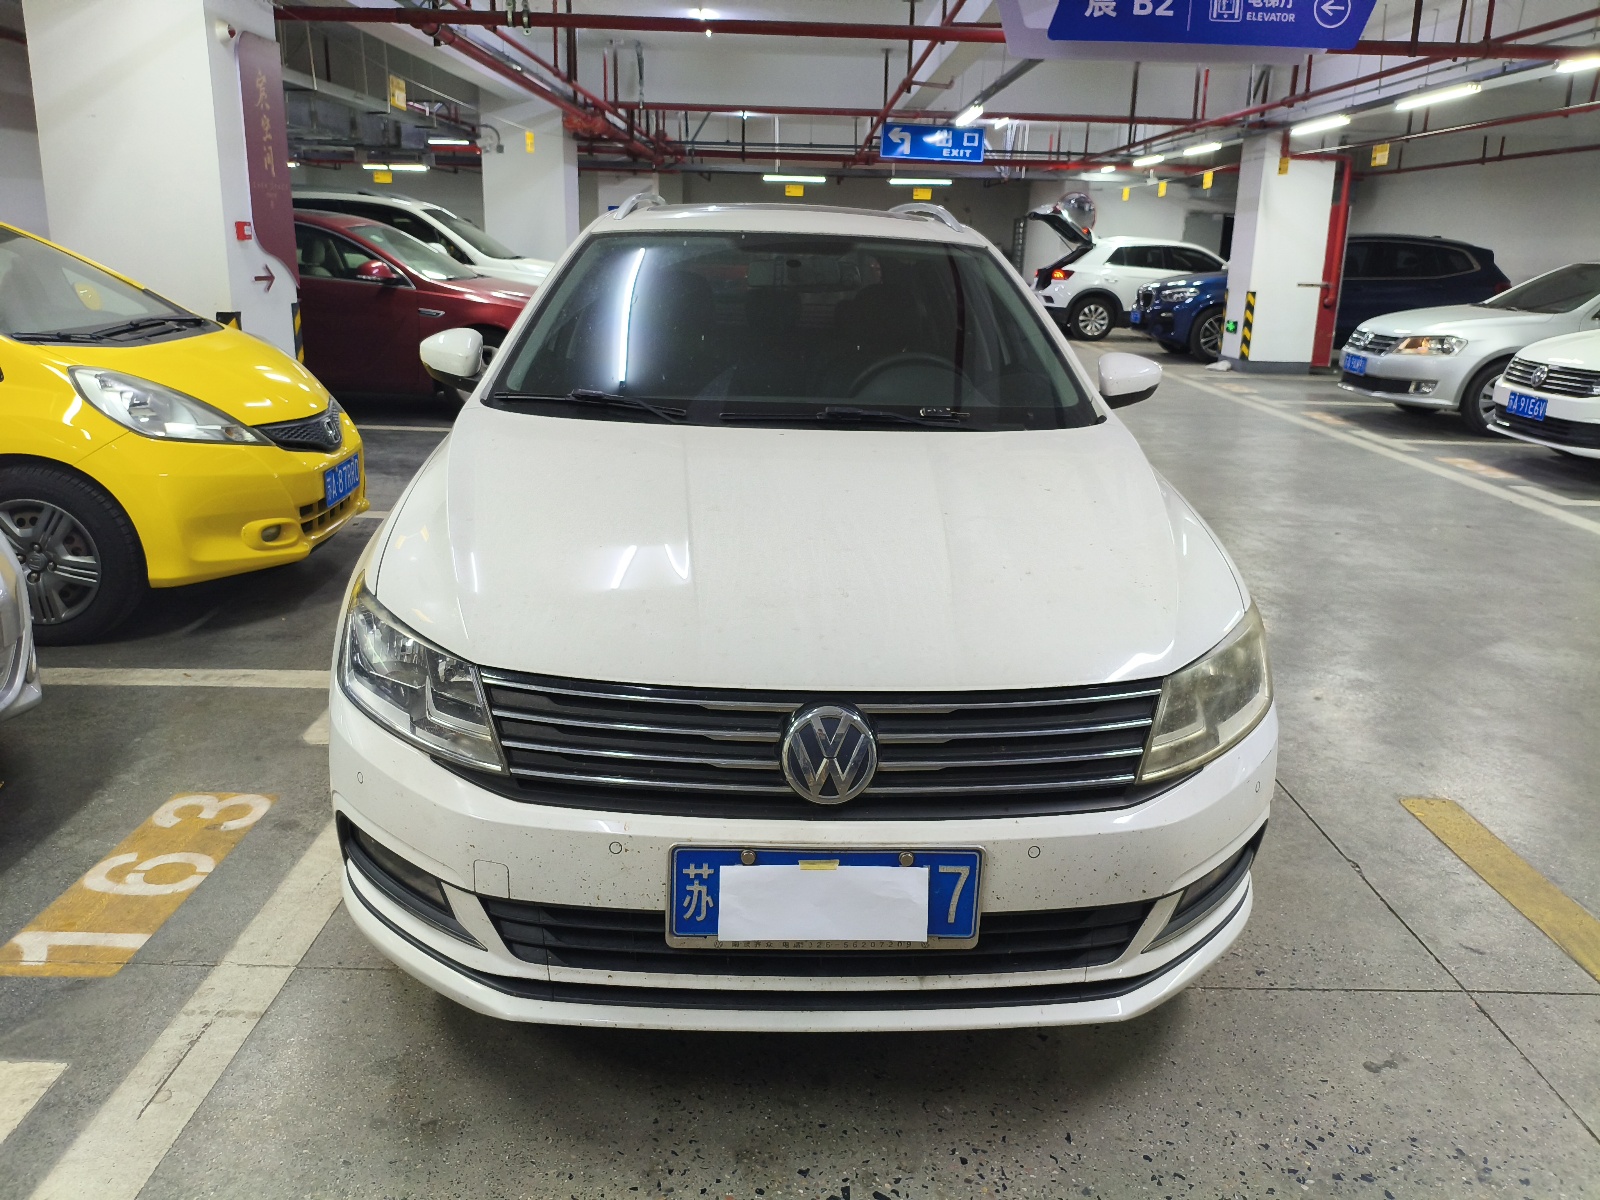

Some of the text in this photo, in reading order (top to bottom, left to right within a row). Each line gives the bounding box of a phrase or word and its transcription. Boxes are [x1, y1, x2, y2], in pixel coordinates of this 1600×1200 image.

[1246, 11, 1296, 23] ELEVATOR
[942, 148, 973, 158] EXIT
[11, 794, 273, 966] 163
